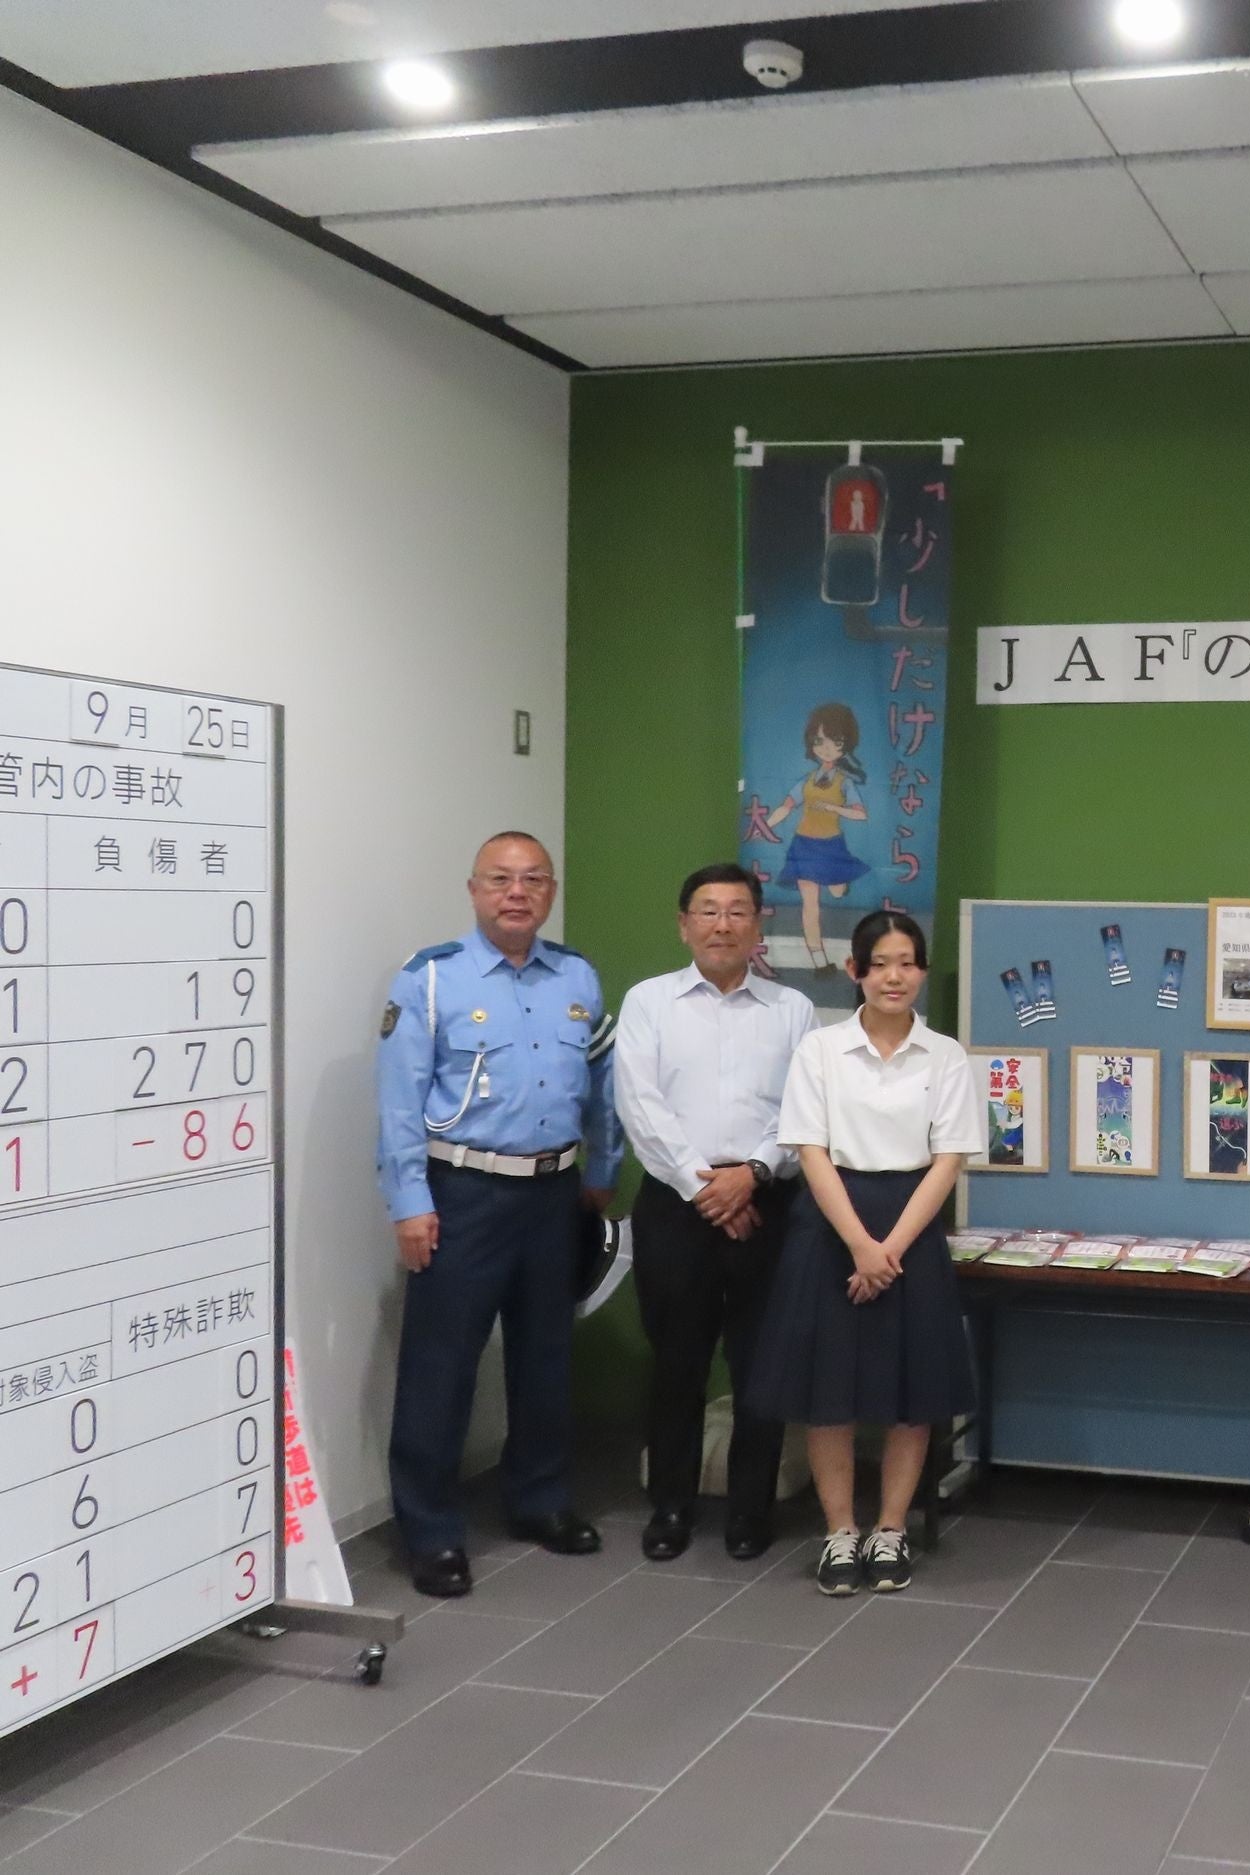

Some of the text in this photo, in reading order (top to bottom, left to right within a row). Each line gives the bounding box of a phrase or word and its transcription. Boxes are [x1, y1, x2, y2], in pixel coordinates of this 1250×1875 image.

[232, 900, 255, 949] 0
[129, 1287, 256, 1352] 特殊詐欺
[235, 1350, 259, 1399] 0
[70, 1398, 98, 1453] 0
[235, 1416, 259, 1466] 0
[71, 1474, 99, 1530] 6
[236, 1482, 259, 1534] 7
